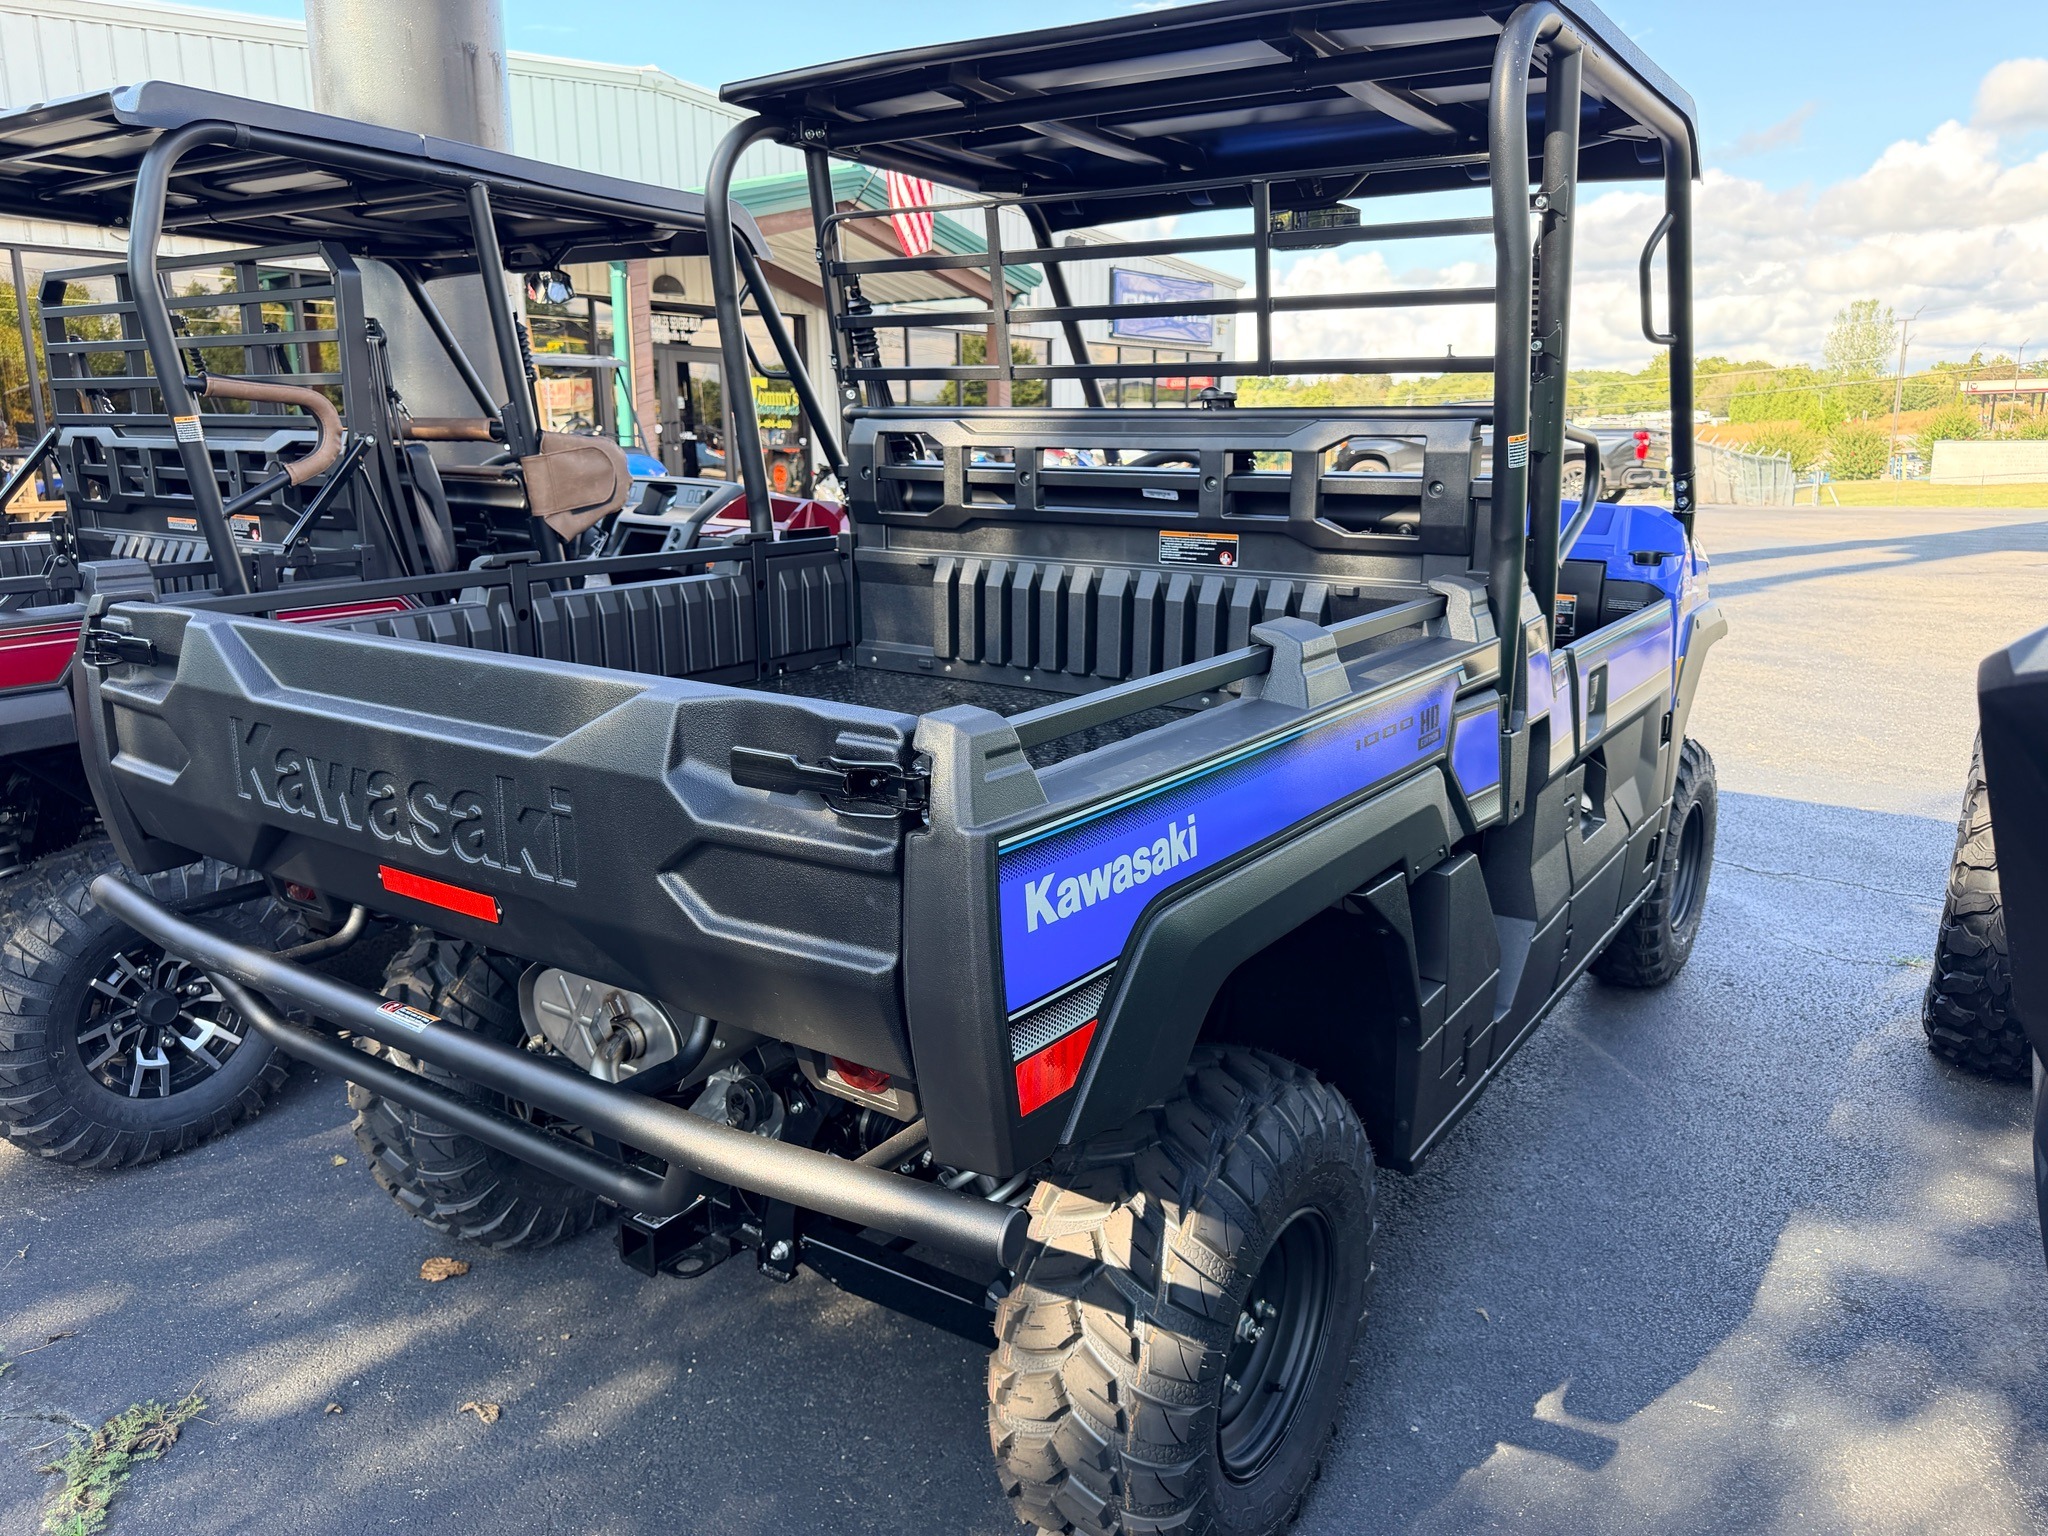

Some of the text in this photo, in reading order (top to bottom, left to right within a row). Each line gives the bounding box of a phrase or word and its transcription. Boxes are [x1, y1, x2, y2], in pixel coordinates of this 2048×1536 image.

[1355, 704, 1440, 751] 1000 HD
[229, 716, 578, 888] Kawasaki
[1025, 813, 1198, 933] Kawasaki
